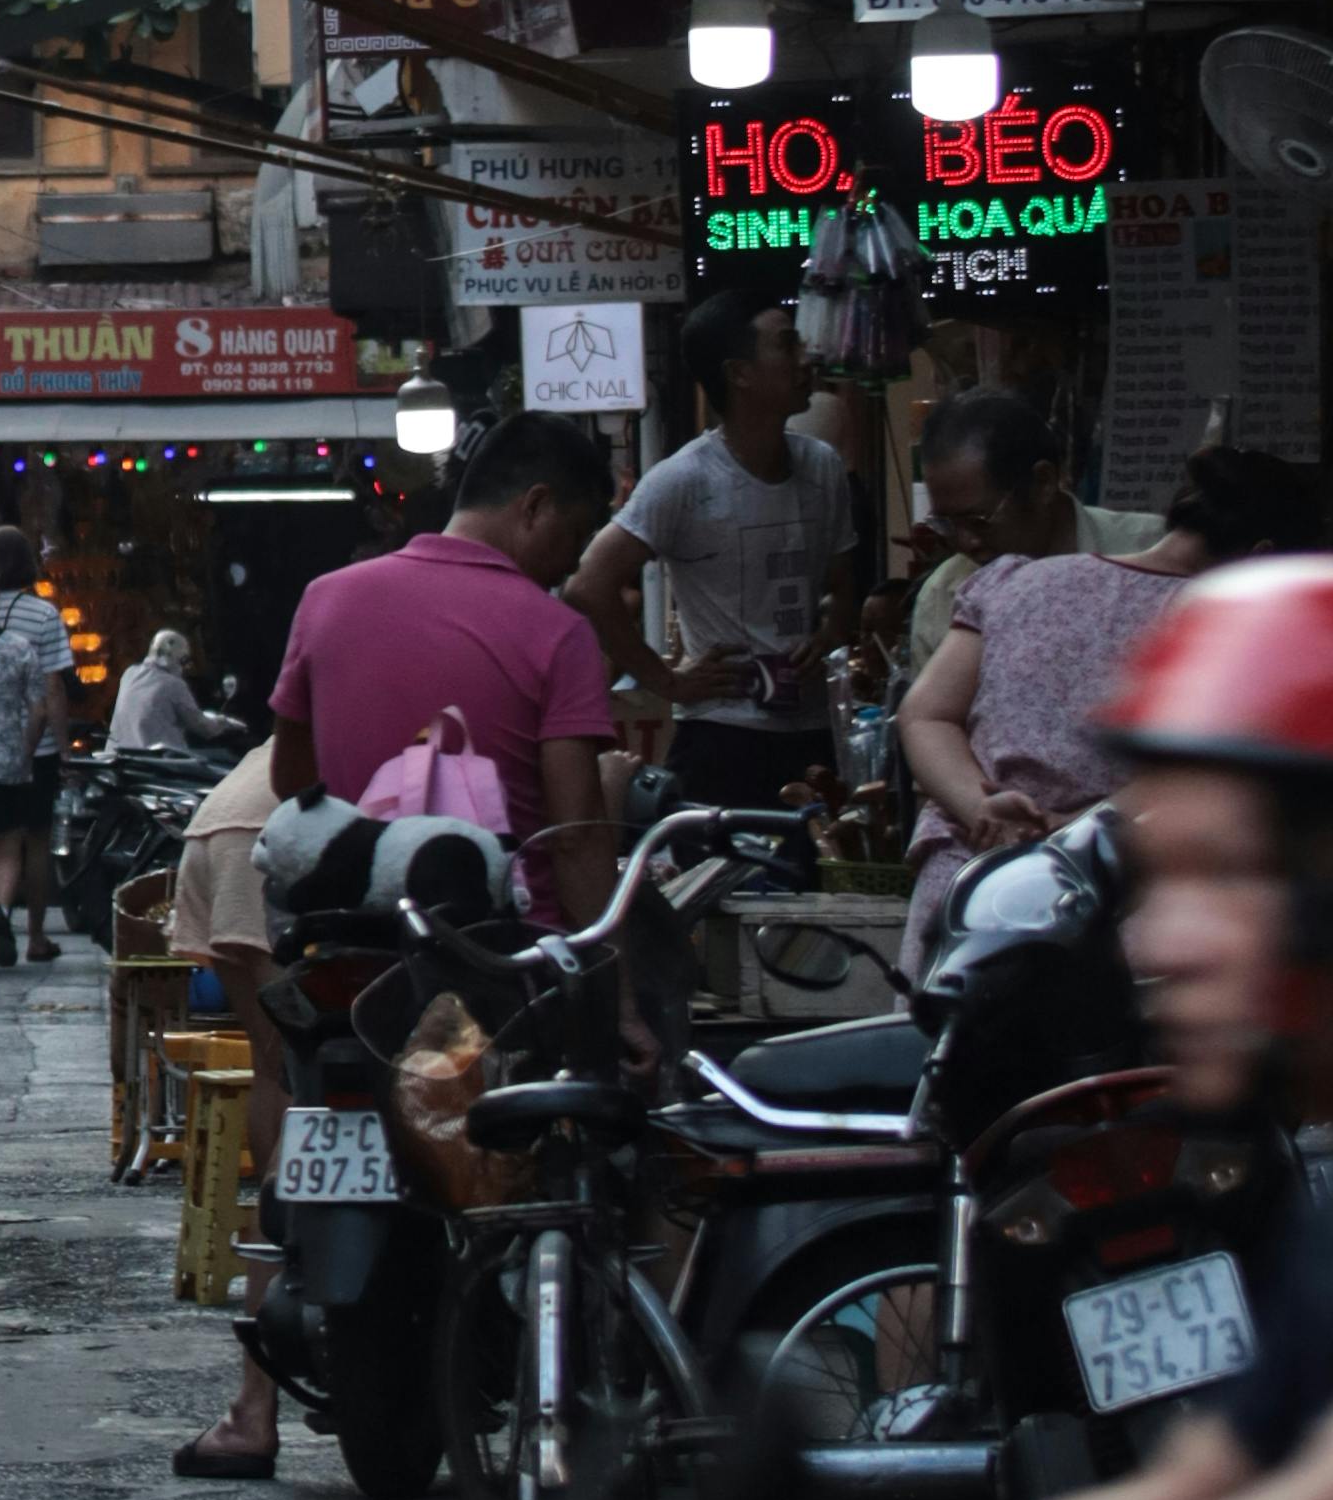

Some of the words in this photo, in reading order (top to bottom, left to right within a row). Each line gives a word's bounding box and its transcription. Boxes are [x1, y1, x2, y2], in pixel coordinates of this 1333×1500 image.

[705, 117, 853, 197] HO
[923, 93, 1112, 186] BÉO
[706, 207, 810, 251] SINH
[918, 197, 1016, 242] HOA
[174, 317, 214, 358] 8
[220, 325, 278, 356] HÀNG
[284, 328, 338, 361] QUẠT
[30, 372, 92, 393] PHONG
[535, 382, 581, 402] CHIC
[586, 380, 634, 400] NAIL
[1090, 1267, 1217, 1345] 29-C1
[1091, 1314, 1249, 1403] 754.73
